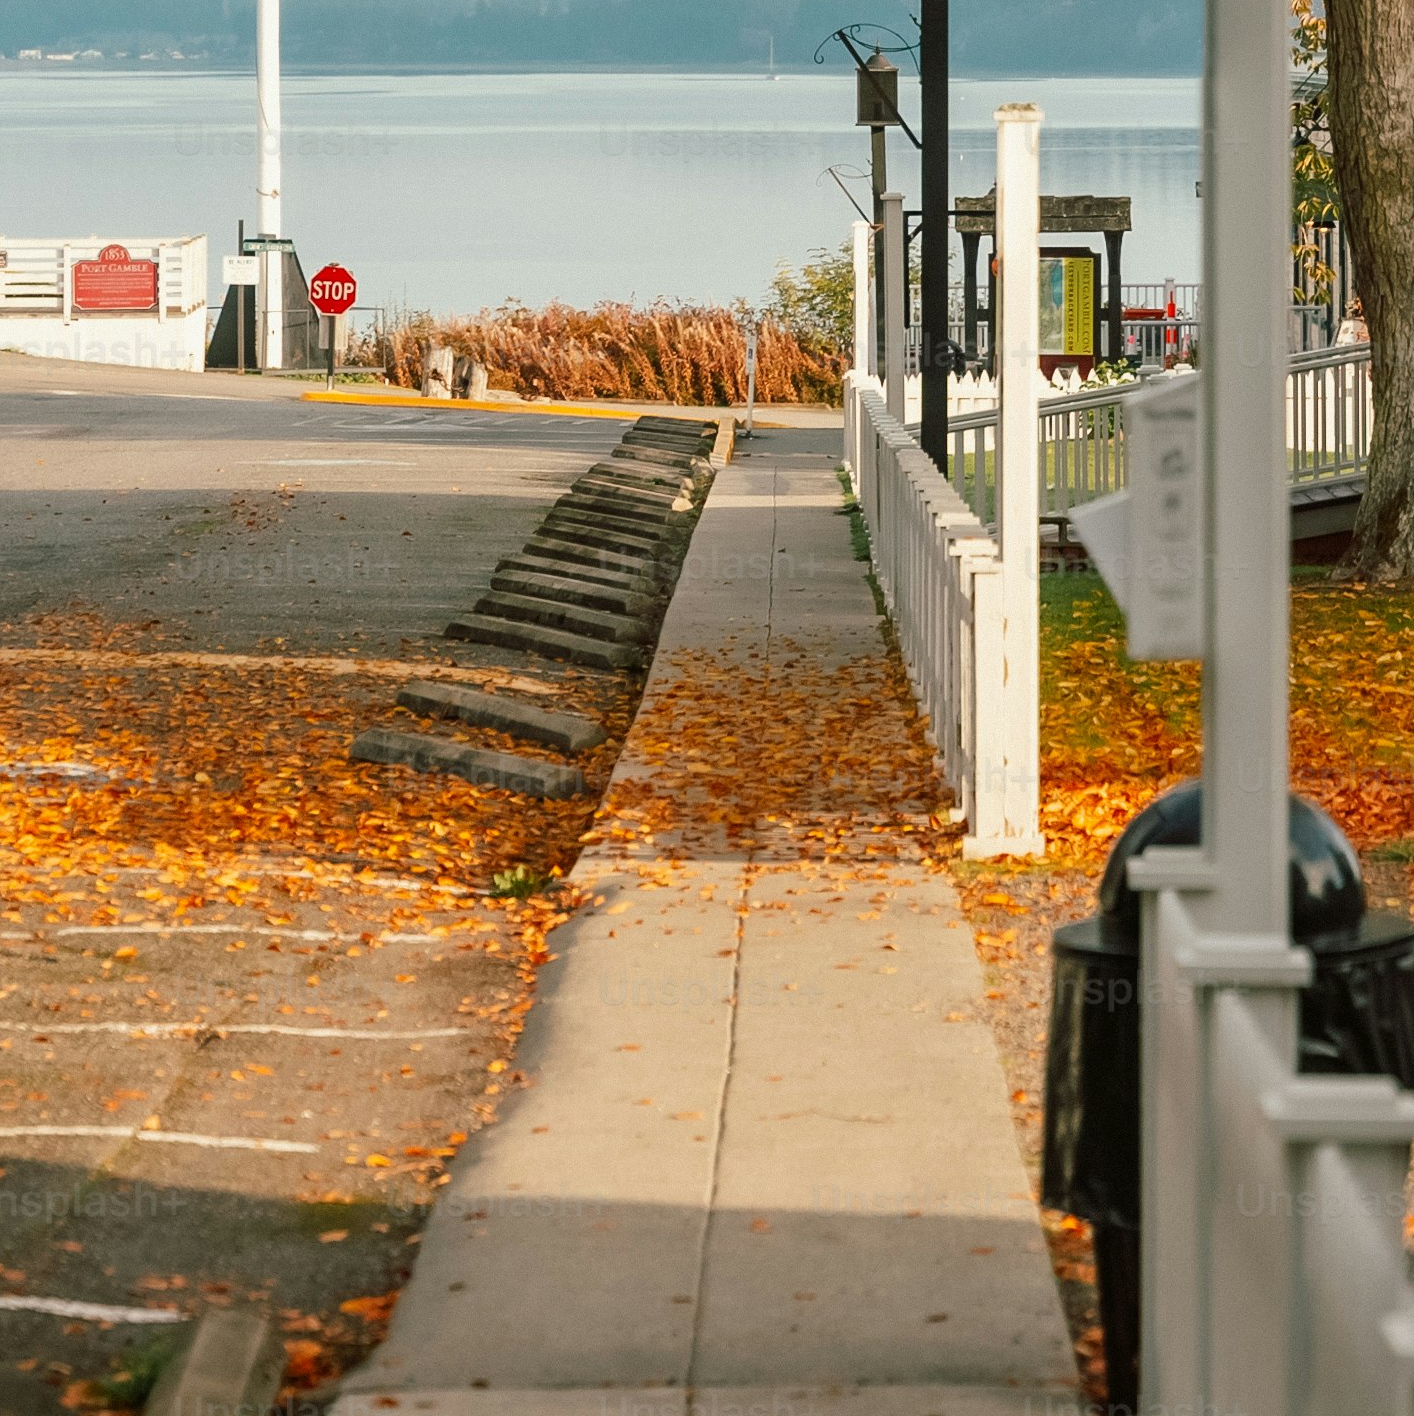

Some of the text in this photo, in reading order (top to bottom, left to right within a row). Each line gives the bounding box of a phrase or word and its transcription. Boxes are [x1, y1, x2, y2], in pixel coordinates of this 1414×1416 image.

[104, 248, 125, 261] 1853
[81, 263, 148, 273] PORT GAMBLE
[312, 280, 355, 301] STOP
